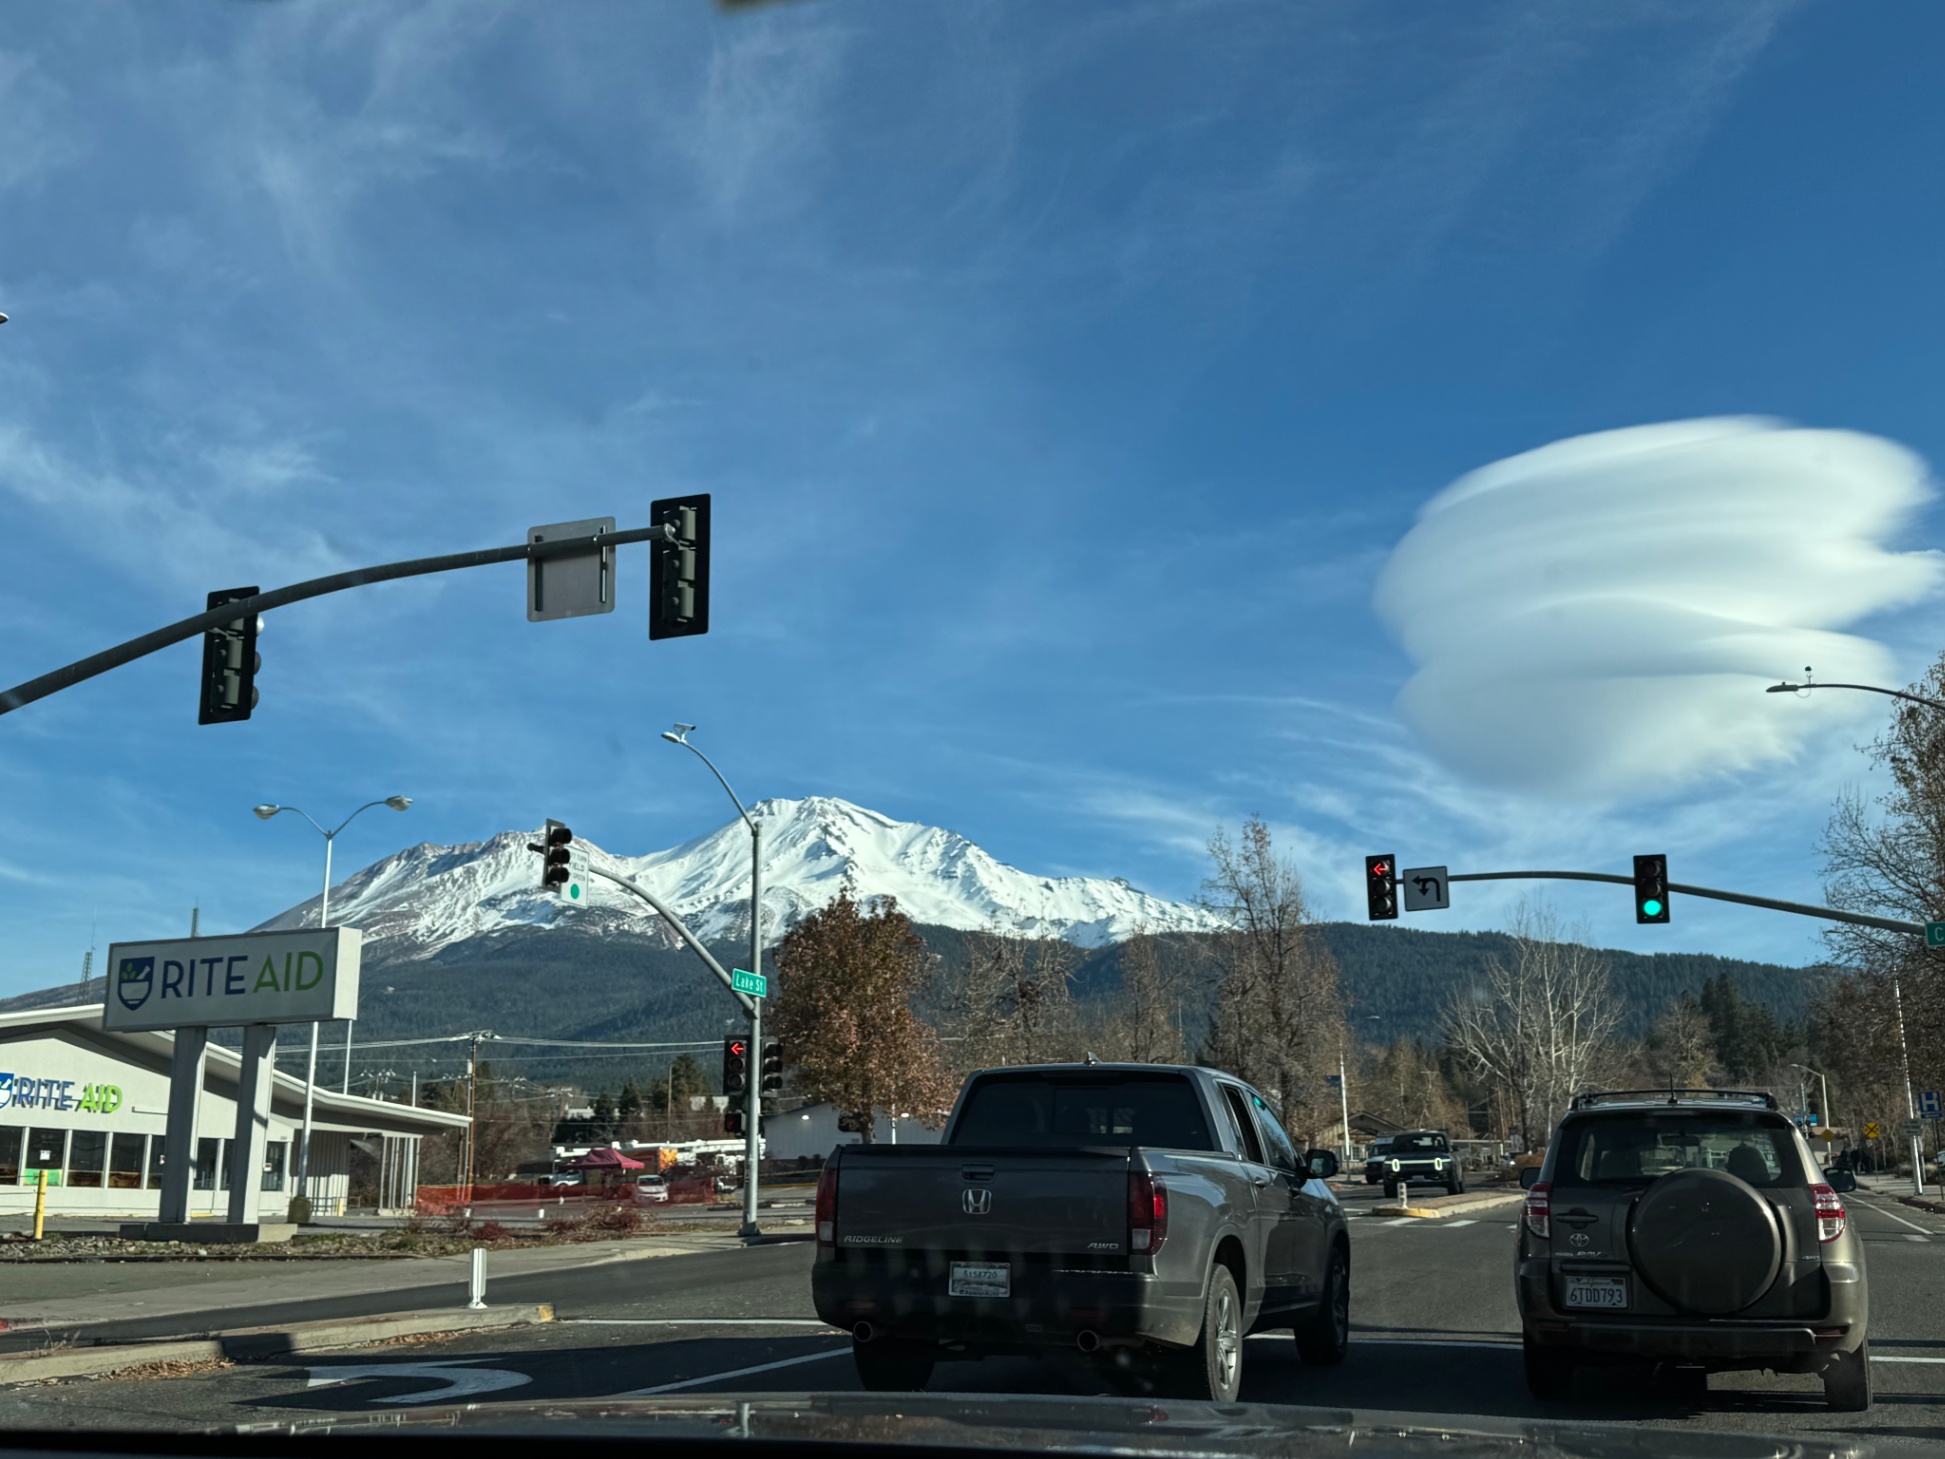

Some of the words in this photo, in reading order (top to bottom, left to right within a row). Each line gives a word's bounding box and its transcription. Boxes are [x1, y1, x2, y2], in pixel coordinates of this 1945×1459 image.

[160, 955, 249, 999] RITE
[253, 951, 324, 993] AID
[735, 973, 754, 990] Lake
[755, 978, 764, 993] St
[16, 1077, 76, 1109] RITE
[80, 1083, 123, 1113] AID
[844, 1235, 904, 1244] RIDGELINE
[1087, 1242, 1120, 1250] AWD
[1570, 1287, 1624, 1304] 6TDD793
